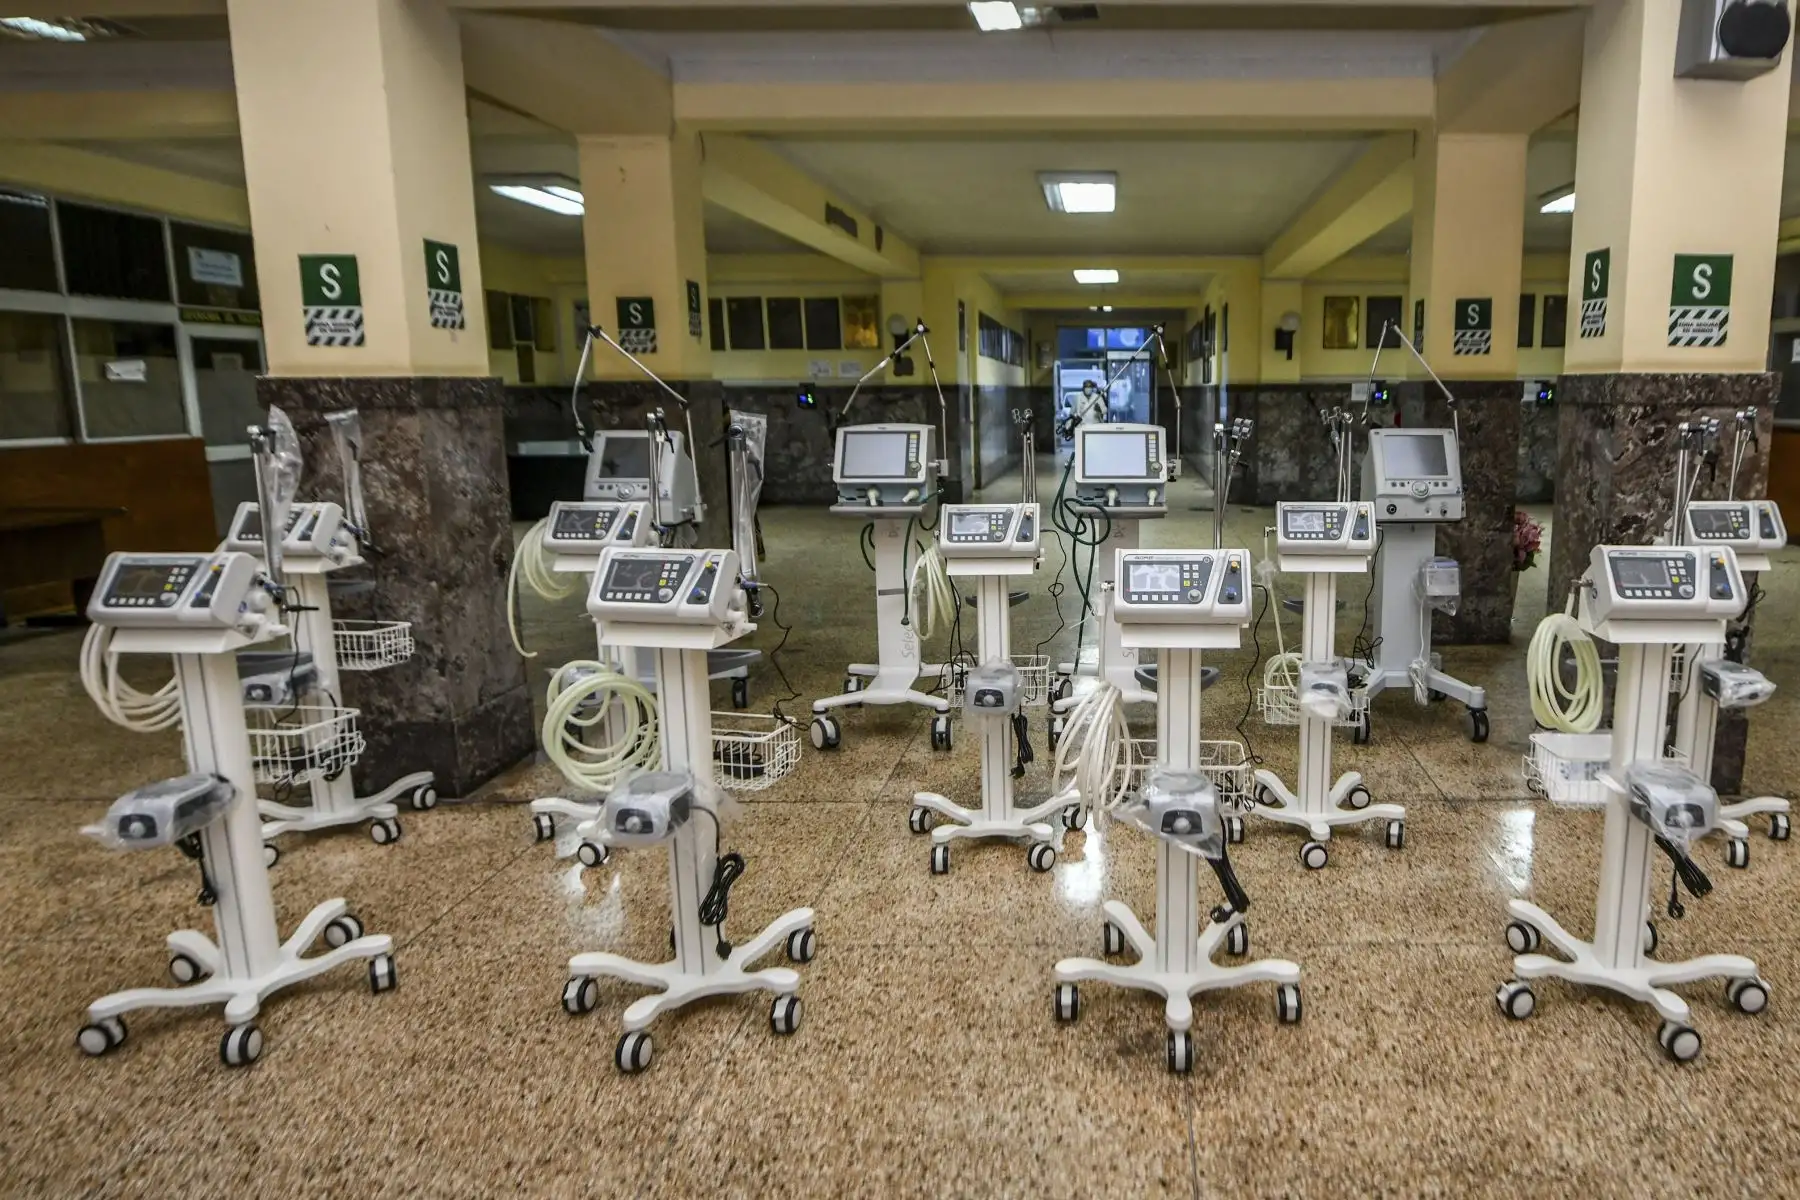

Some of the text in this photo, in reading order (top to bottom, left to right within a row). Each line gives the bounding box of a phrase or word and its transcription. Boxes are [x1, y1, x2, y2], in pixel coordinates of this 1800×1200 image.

[319, 262, 342, 301] S
[435, 249, 451, 285] S
[1591, 257, 1602, 293] S
[1691, 262, 1713, 301] S
[628, 302, 643, 325] S
[1467, 303, 1480, 326] S
[900, 625, 915, 661] Selec
